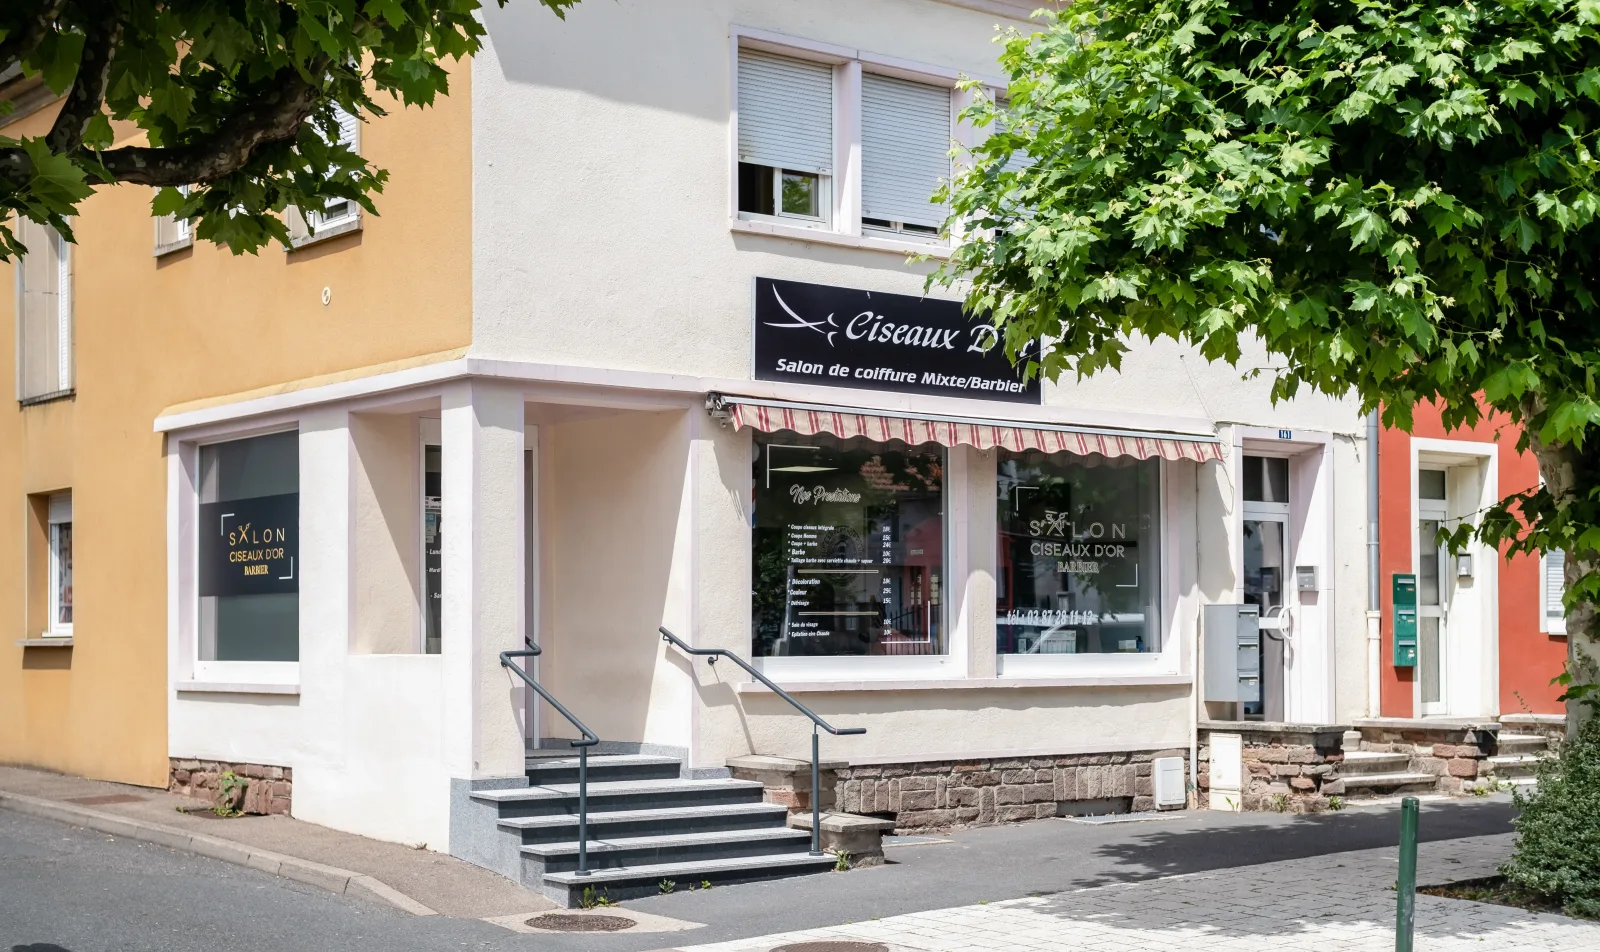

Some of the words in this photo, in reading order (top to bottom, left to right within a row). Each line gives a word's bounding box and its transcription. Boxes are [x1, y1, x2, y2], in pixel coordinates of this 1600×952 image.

[845, 311, 960, 350] Ciseaux
[775, 358, 824, 375] Salon
[828, 363, 850, 377] de
[854, 367, 917, 384] coiffure
[921, 371, 1025, 393] Mixte/Barbier
[1280, 430, 1290, 439] 161
[229, 550, 264, 563] CISEAUX
[265, 547, 285, 560] D'OR
[1030, 543, 1090, 557] CISEAUX
[1094, 544, 1125, 558] D'OR
[244, 564, 269, 576] BARBIER
[1057, 561, 1099, 573] BARBIER
[1027, 609, 1039, 625] 03
[1041, 609, 1053, 625] 87
[1055, 609, 1067, 625] 28
[1069, 609, 1079, 625] 11
[1082, 610, 1093, 625] 12
